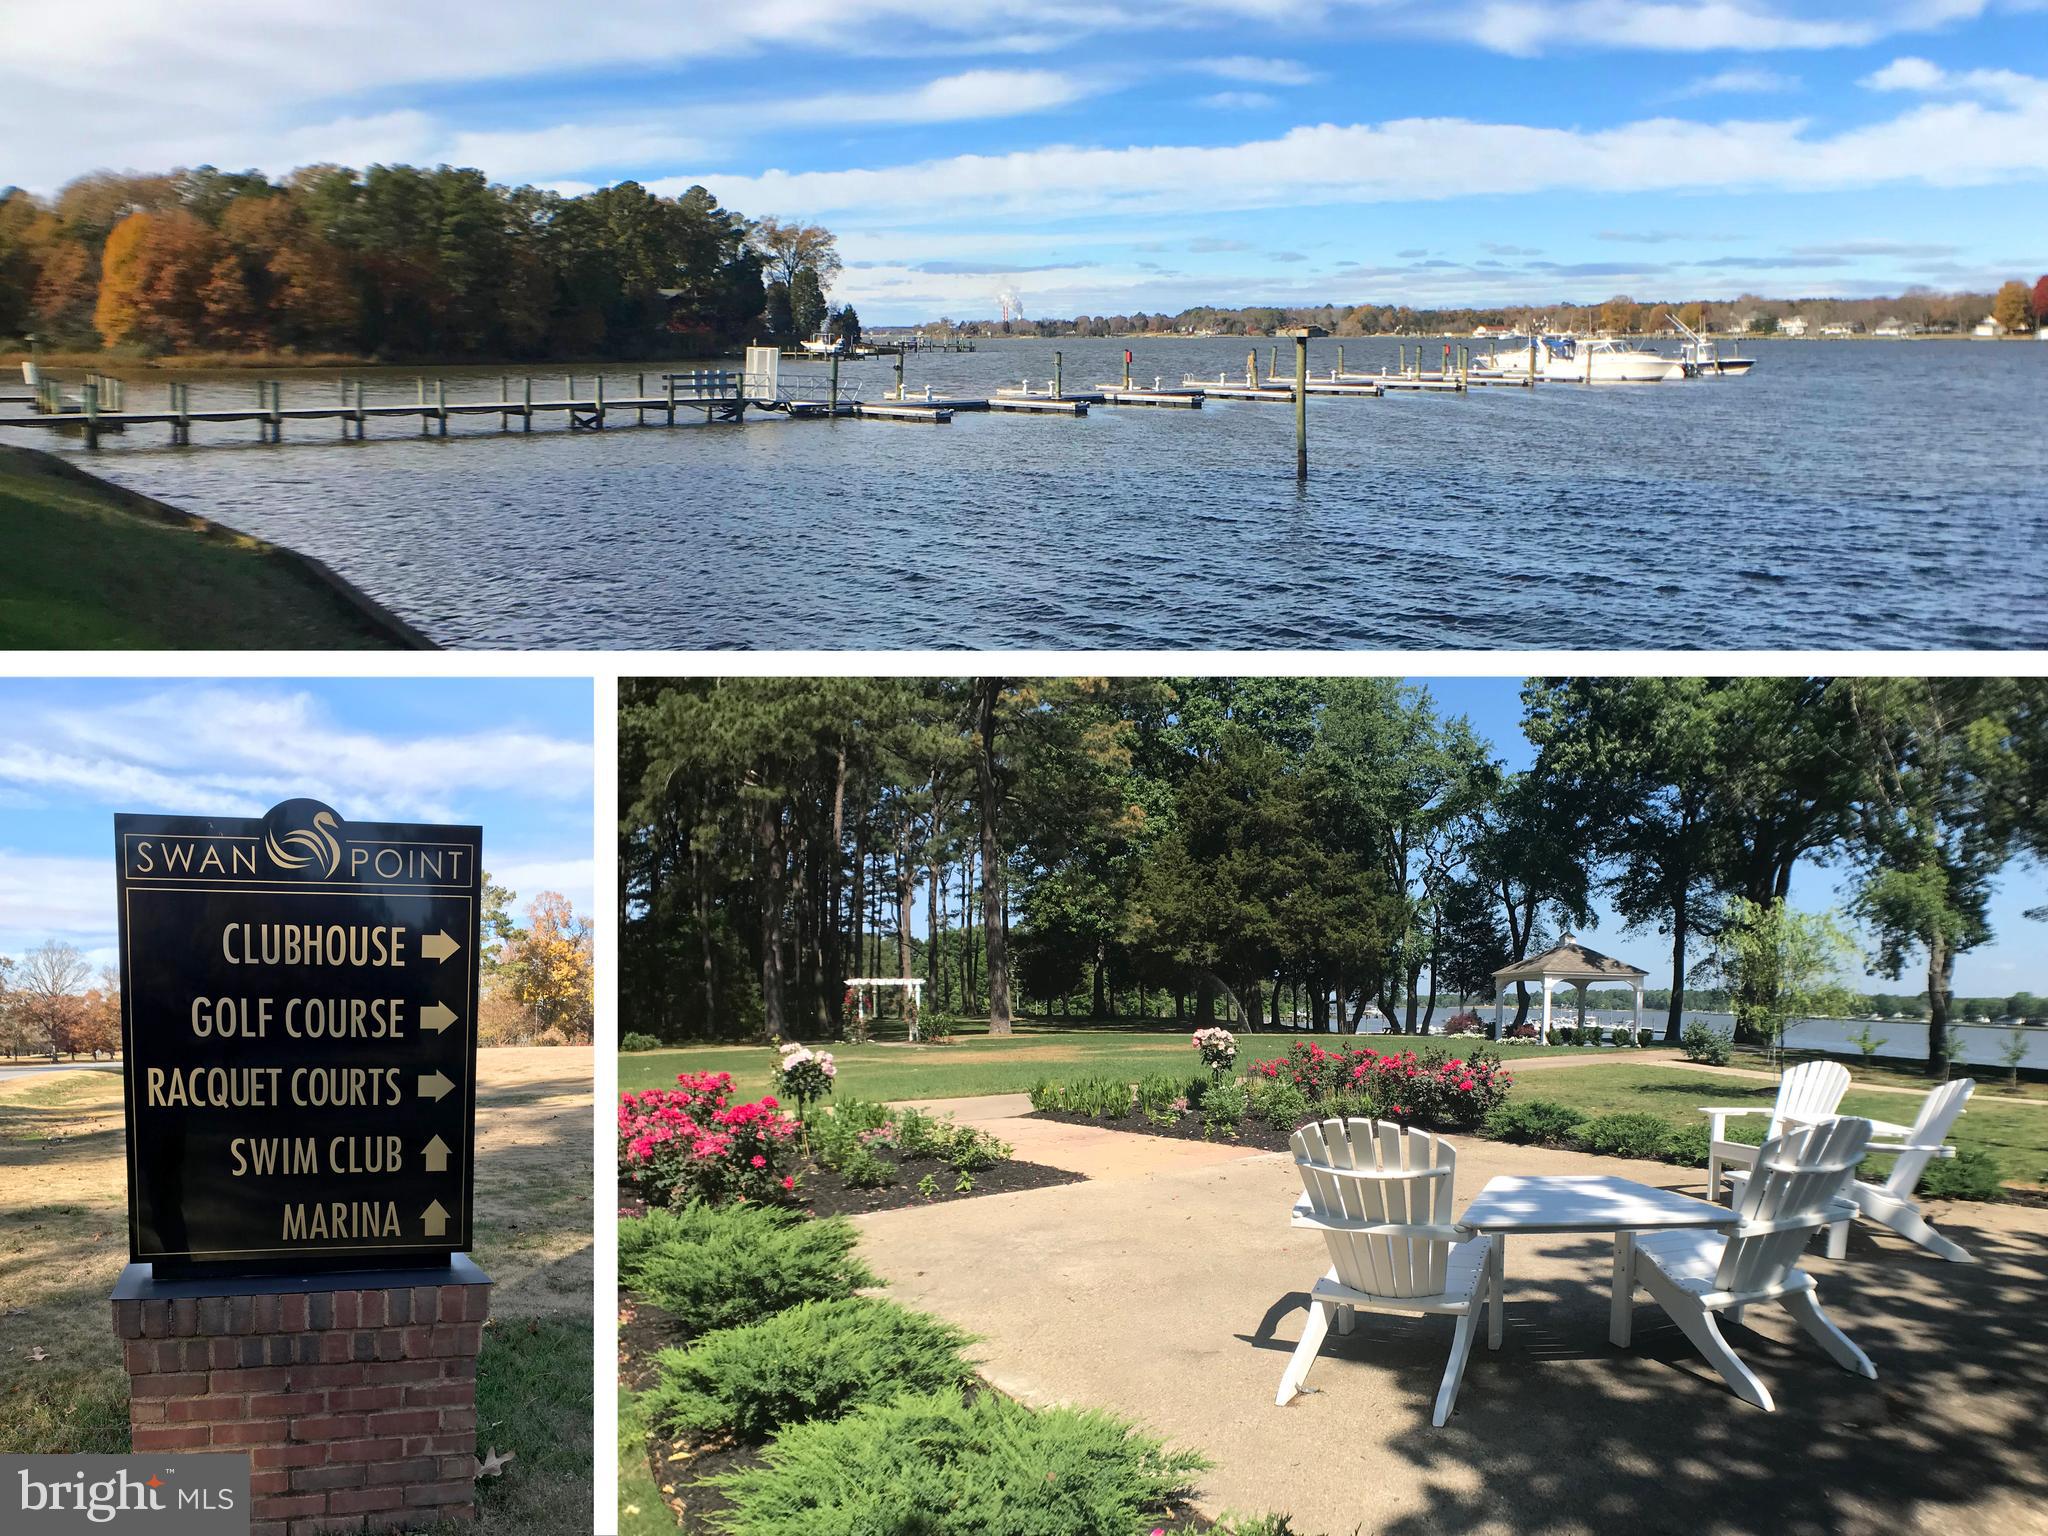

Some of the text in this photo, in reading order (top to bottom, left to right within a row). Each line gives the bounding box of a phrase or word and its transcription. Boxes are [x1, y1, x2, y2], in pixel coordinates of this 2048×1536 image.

[136, 841, 464, 880] SWAN POINT
[222, 922, 406, 966] CLUBHOUSE
[191, 997, 404, 1038] GOLF COURSE
[147, 1067, 401, 1108] RACQUET COURTS
[230, 1135, 402, 1176] SWIM CLUB
[282, 1201, 401, 1240] MARINA
